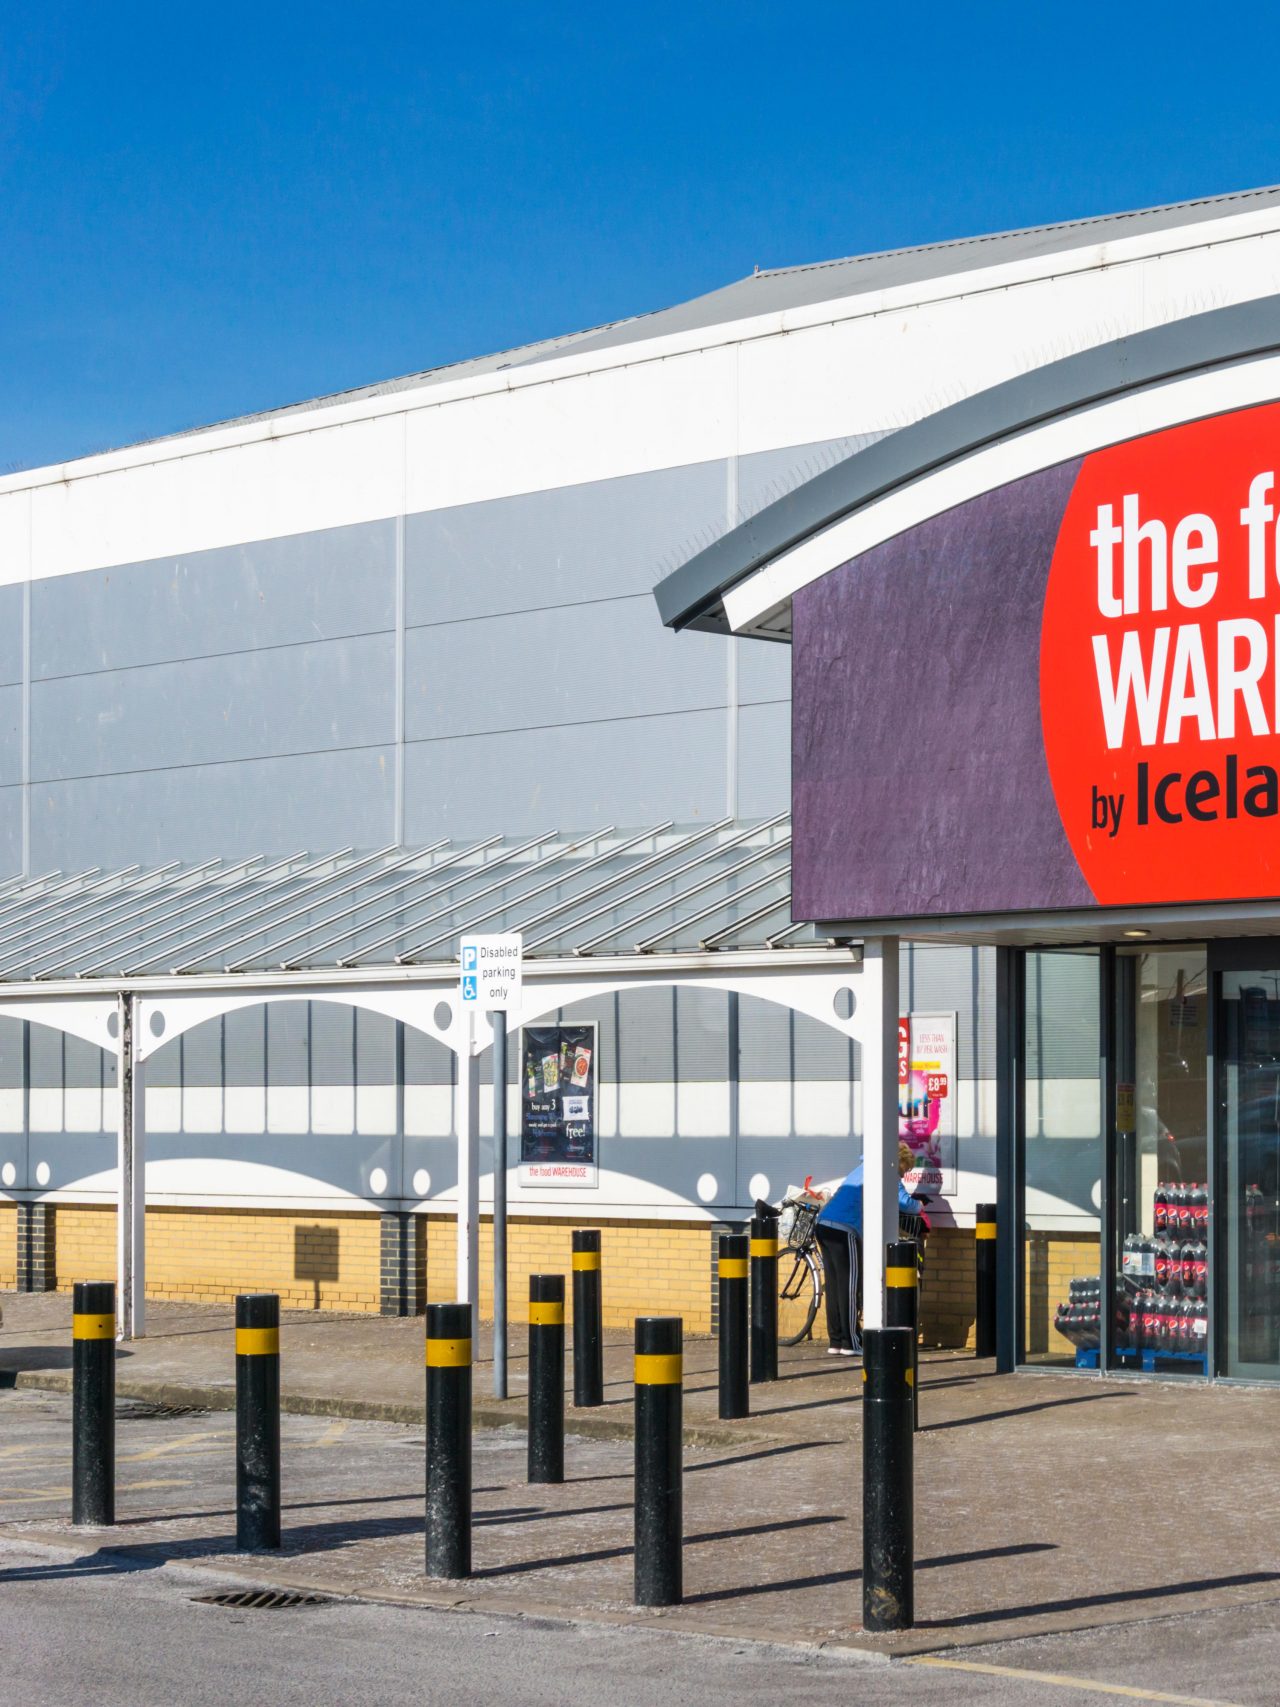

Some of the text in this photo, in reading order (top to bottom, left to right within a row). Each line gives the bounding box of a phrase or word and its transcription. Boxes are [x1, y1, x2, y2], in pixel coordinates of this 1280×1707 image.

[1089, 493, 1219, 618] the
[1091, 785, 1125, 837] by
[480, 946, 518, 958] Disabled
[482, 966, 516, 980] parking
[489, 986, 508, 1000] only
[551, 1098, 556, 1111] 3
[898, 1091, 932, 1118] urf
[565, 1122, 586, 1139] free!
[552, 1167, 586, 1178] WAREHOUSE
[904, 1172, 944, 1184] WAREHOUSE
